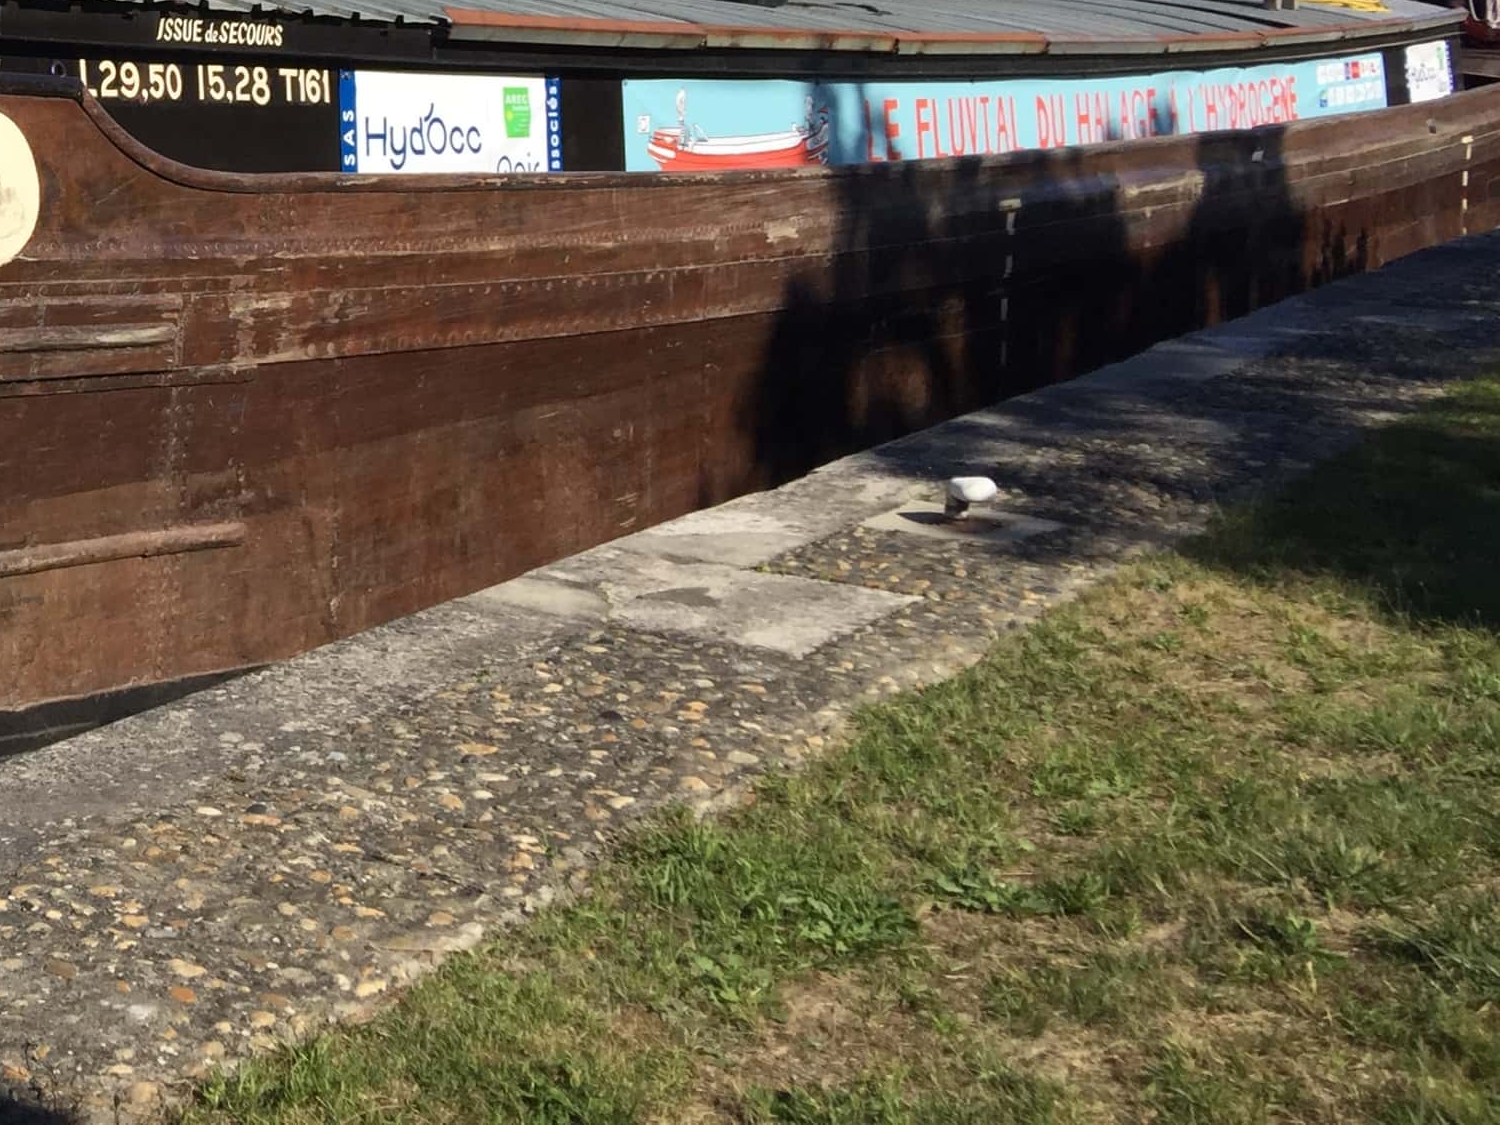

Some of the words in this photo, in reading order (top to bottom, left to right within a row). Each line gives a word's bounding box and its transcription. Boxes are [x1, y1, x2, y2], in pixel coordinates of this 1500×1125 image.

[156, 17, 204, 43] ISSUE
[204, 22, 219, 43] de
[219, 20, 283, 46] SECOURS
[546, 85, 561, 169] ssociés
[864, 98, 902, 162] LE
[915, 95, 1025, 160] FLUVIAL
[1036, 94, 1065, 149] DU
[1075, 88, 1158, 145] HALAGE
